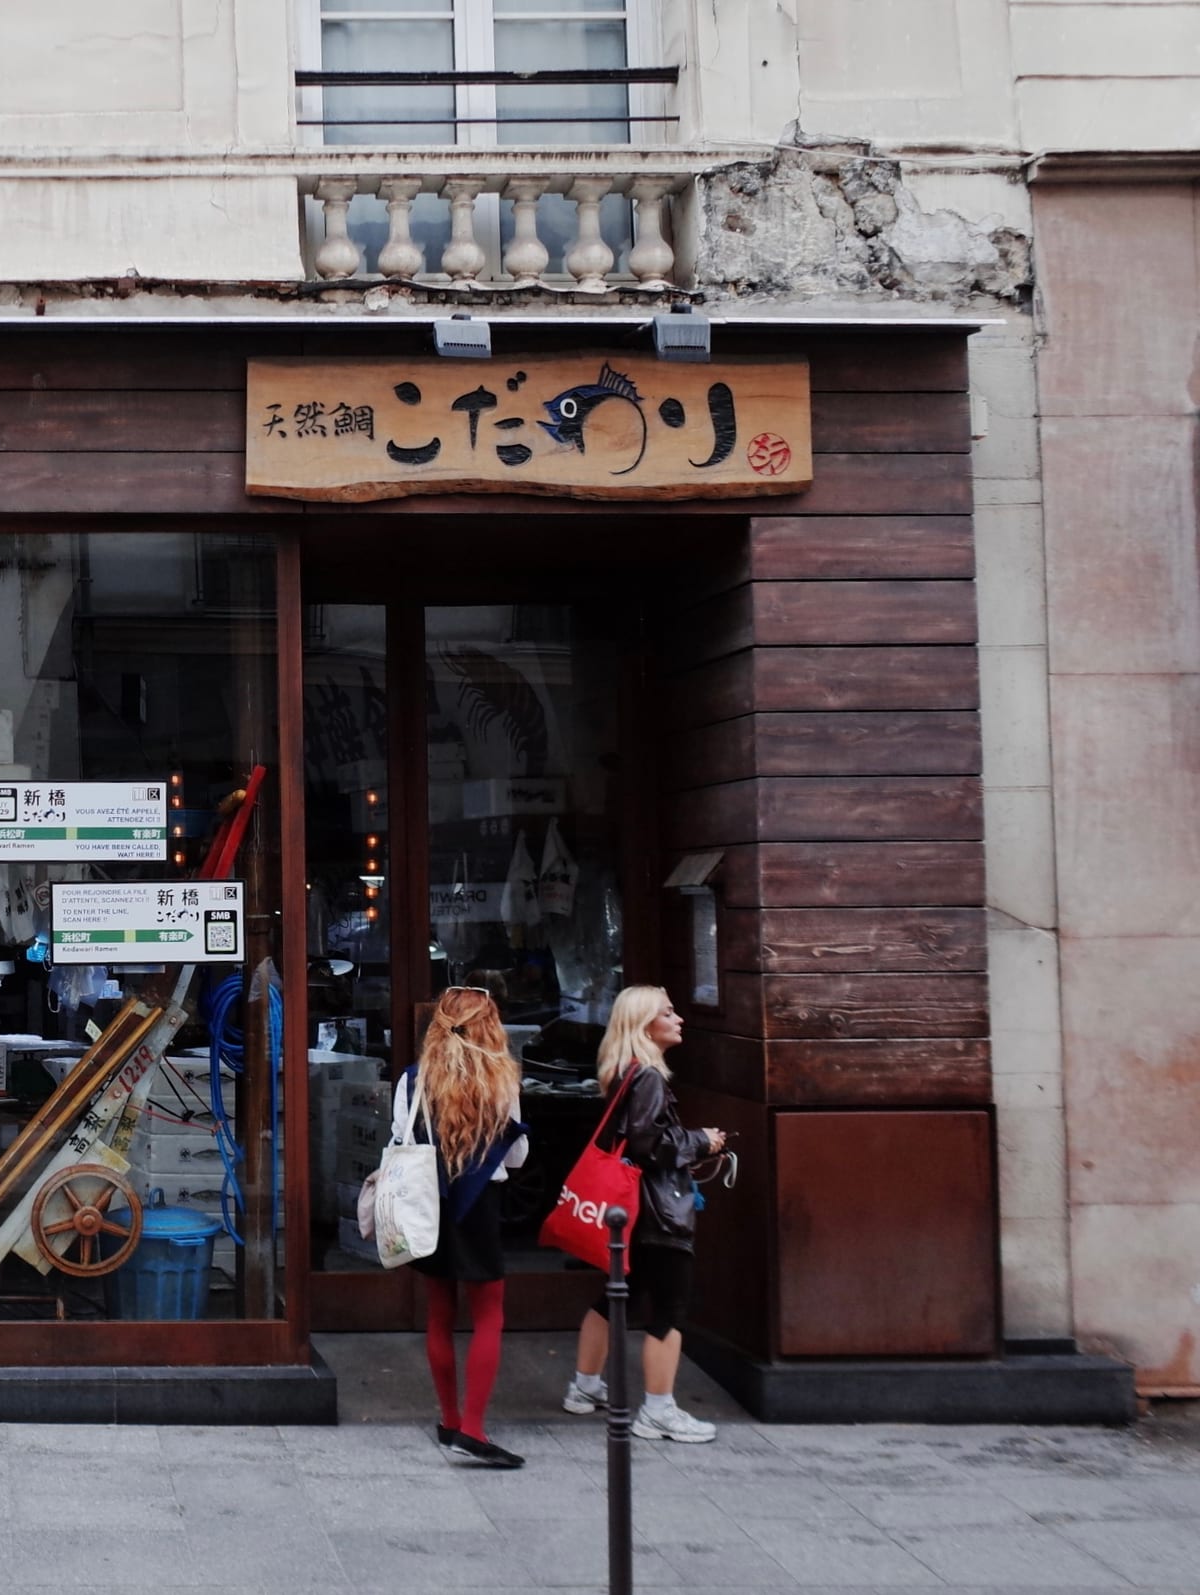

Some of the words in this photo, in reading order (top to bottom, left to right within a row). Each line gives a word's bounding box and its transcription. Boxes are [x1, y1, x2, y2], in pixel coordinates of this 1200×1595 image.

[262, 402, 375, 441] 天然鯛
[23, 789, 66, 806] 新橋
[157, 888, 199, 906] 新橋
[210, 911, 231, 921] SMB
[118, 1045, 154, 1092] 1219
